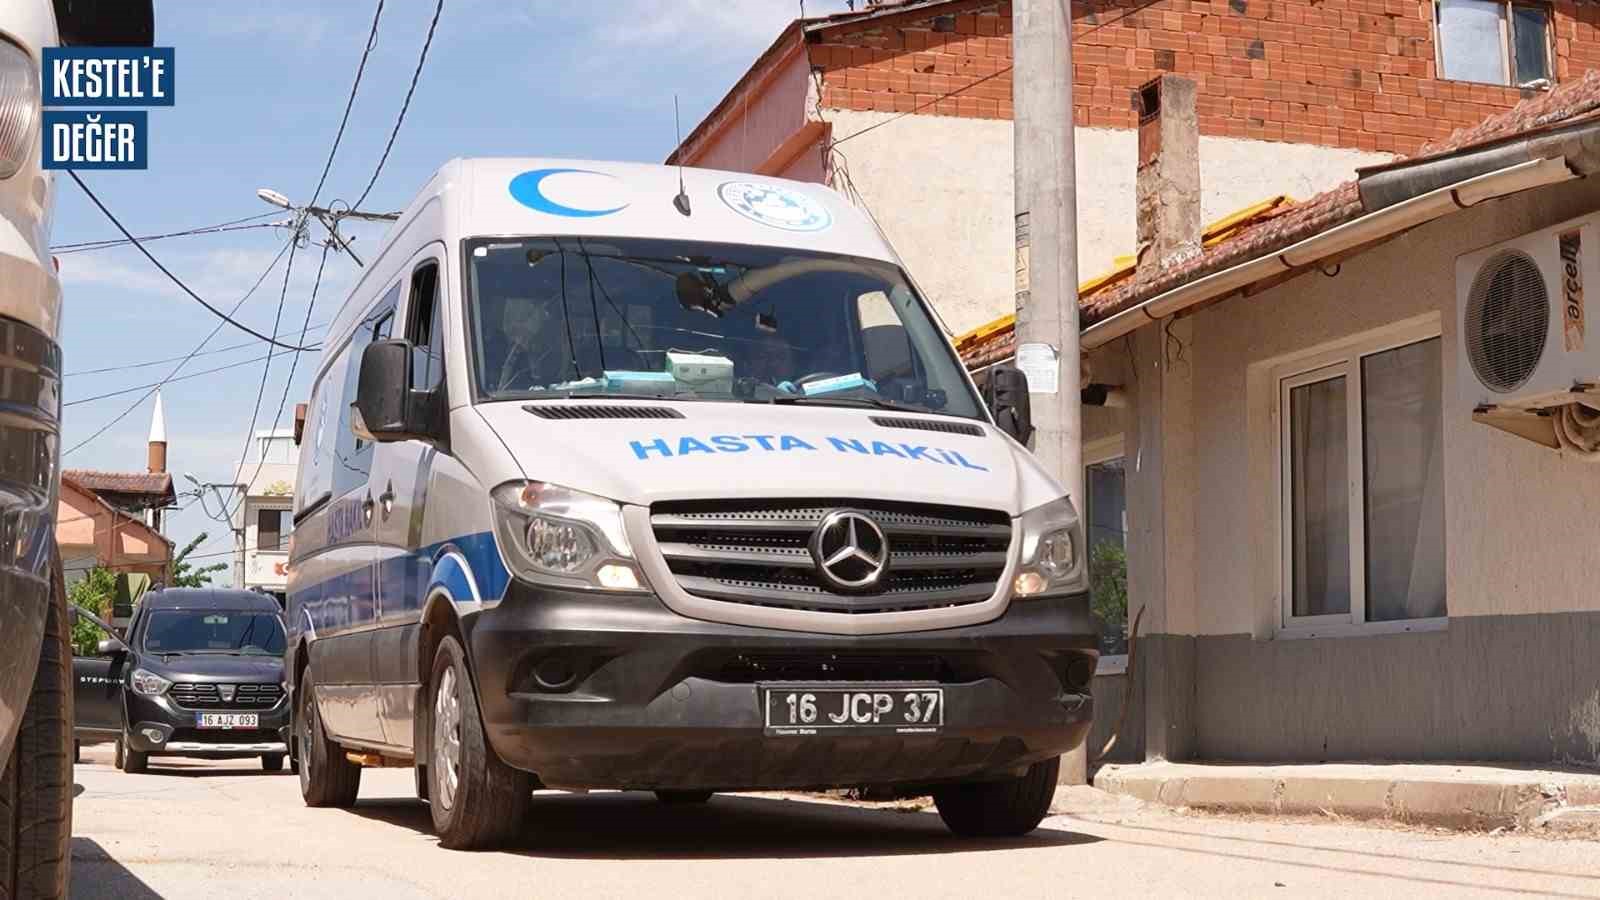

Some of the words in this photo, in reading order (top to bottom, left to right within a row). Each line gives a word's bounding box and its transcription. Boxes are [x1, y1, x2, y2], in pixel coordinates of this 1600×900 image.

[630, 435, 817, 460] HASTA
[203, 715, 214, 726] 16
[217, 715, 234, 726] AJZ
[239, 715, 257, 726] 093
[786, 693, 818, 724] 16
[827, 693, 894, 724] JCP
[903, 692, 939, 723] 37
